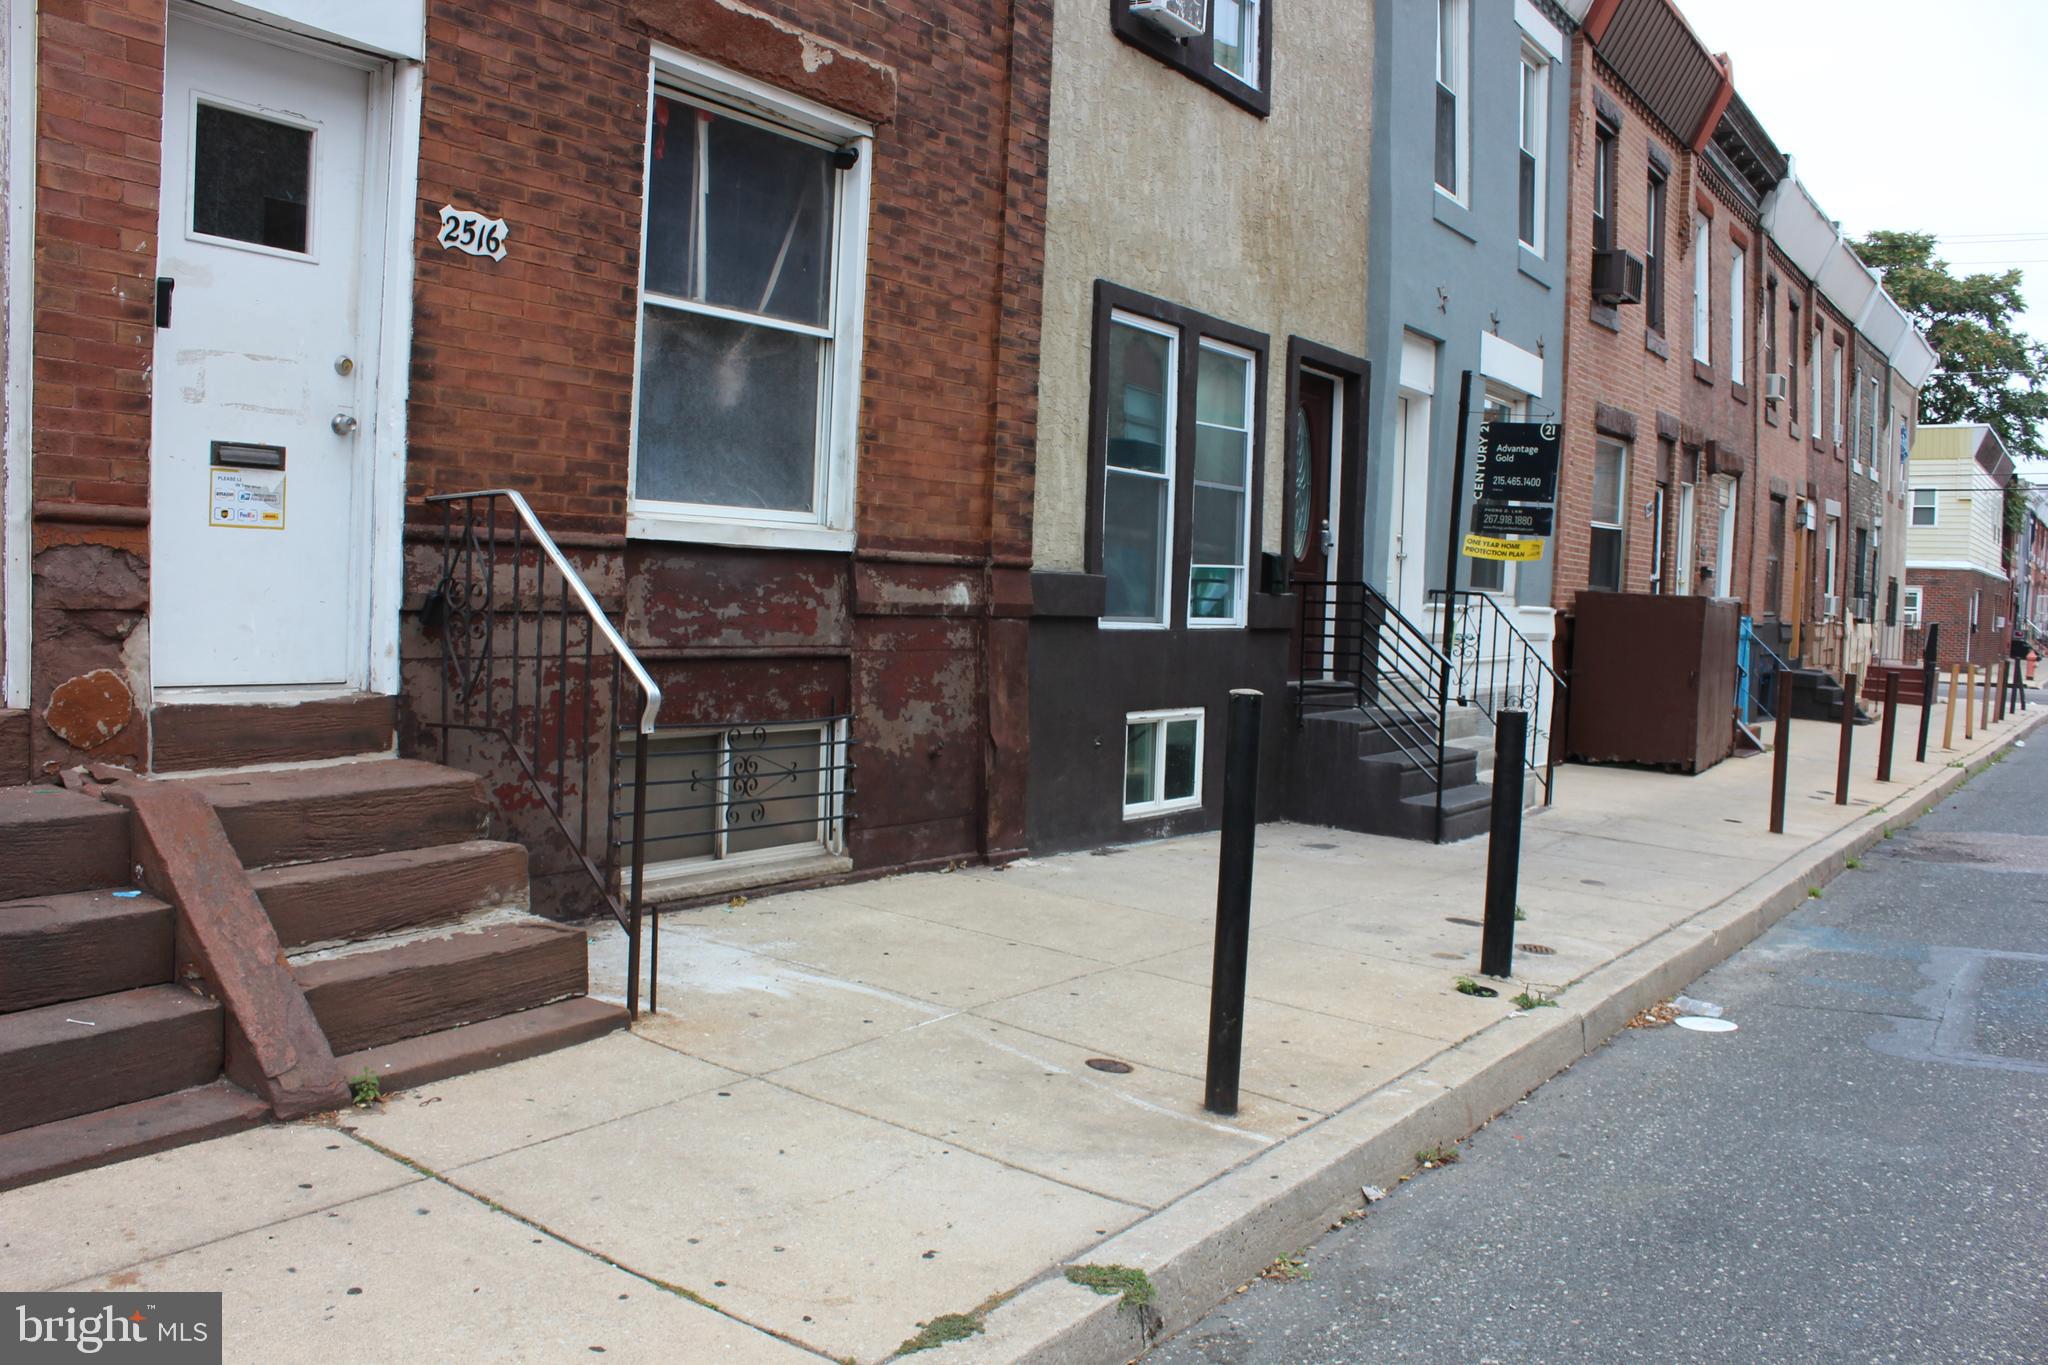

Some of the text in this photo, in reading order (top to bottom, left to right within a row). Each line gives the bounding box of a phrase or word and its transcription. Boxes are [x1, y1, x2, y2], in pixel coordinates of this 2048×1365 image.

[444, 215, 500, 253] 2516
[1545, 425, 1556, 436] 21
[1496, 444, 1539, 456] Advantage
[1473, 421, 1490, 500] CENTURY 21
[1495, 453, 1515, 463] Gold
[1492, 476, 1541, 487] 215.465.1400
[1483, 514, 1533, 526] 267.918.1880
[1466, 538, 1482, 546] ONE
[1465, 546, 1507, 557] PROTECTION
